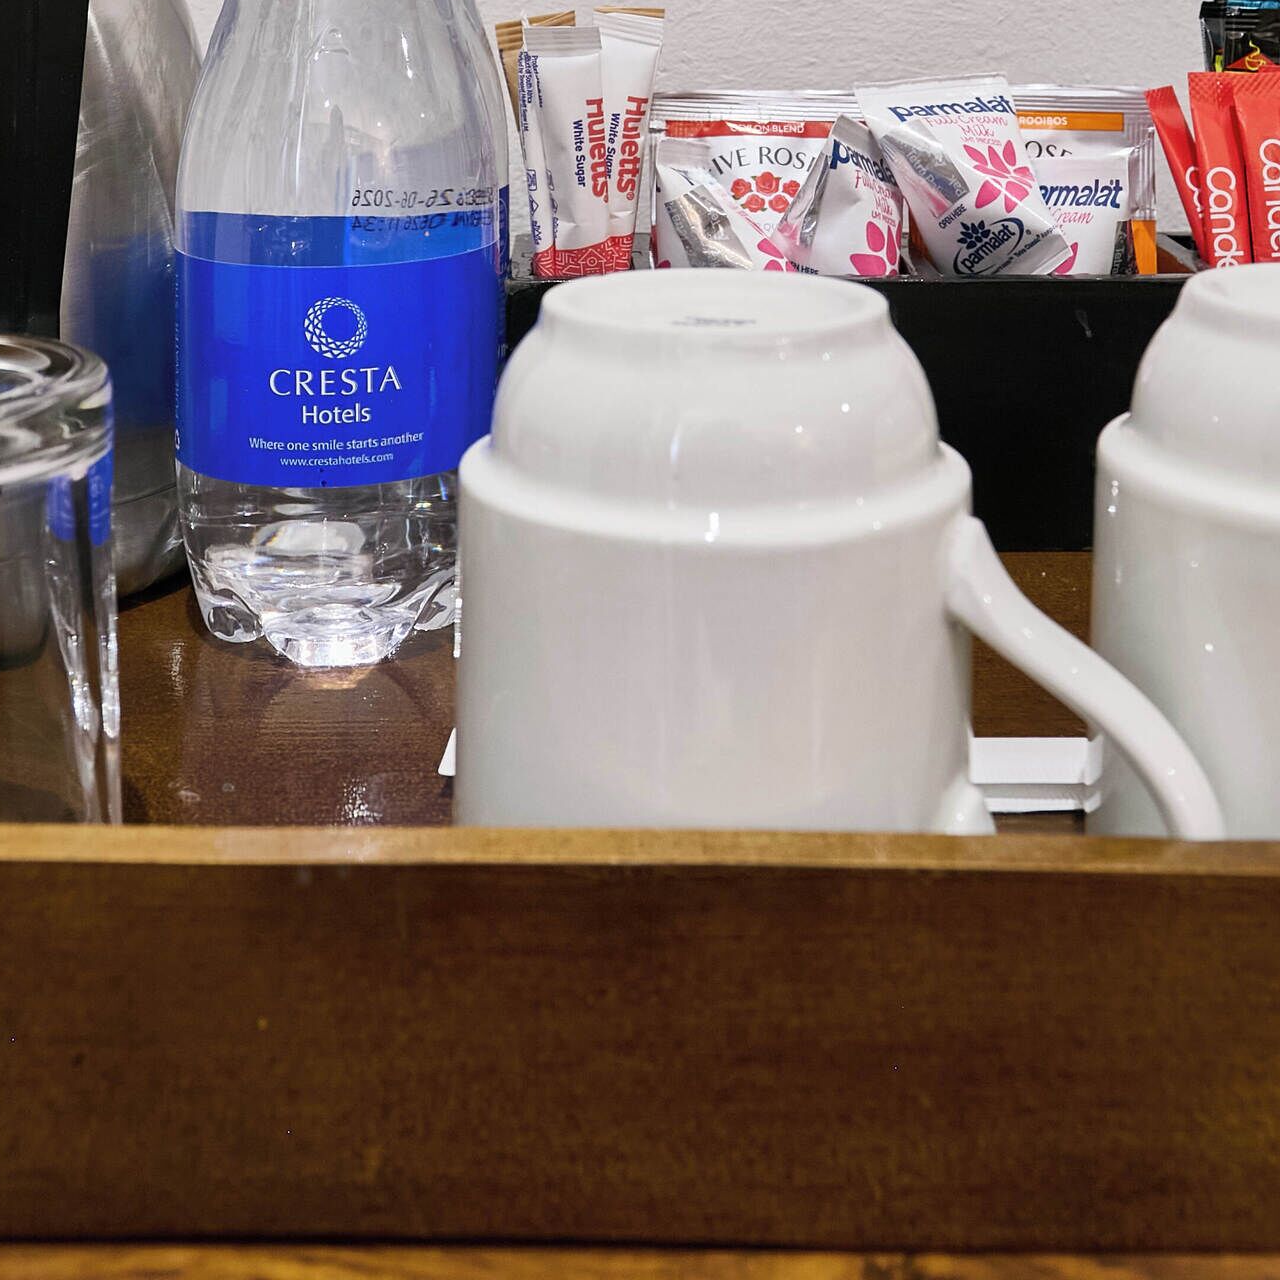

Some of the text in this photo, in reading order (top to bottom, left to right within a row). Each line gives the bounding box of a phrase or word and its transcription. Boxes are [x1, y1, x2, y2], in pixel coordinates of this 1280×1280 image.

[608, 112, 620, 145] White
[772, 124, 805, 134] BLEND
[1019, 116, 1068, 126] ROOIBOS
[573, 120, 586, 187] White Sugar
[709, 147, 750, 175] IVE
[961, 223, 1016, 272] parmalat
[269, 366, 402, 396] CRESTA
[302, 403, 371, 424] Hotels
[249, 431, 424, 451] Where one smile starts another
[280, 452, 394, 467] www.crestahotels.com
